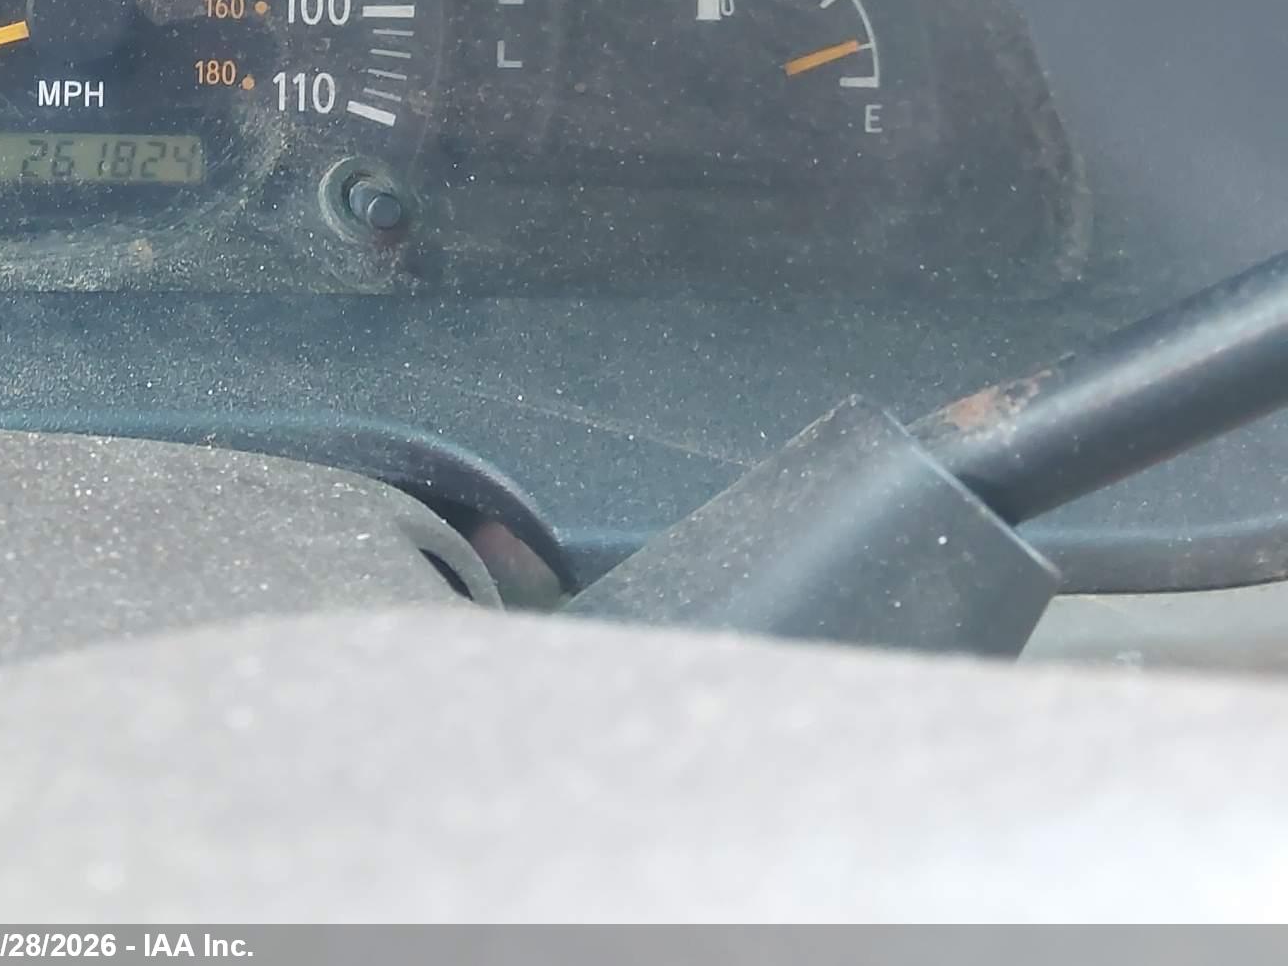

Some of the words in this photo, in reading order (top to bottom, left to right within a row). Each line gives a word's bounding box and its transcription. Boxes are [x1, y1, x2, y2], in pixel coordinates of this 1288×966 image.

[497, 41, 523, 69] L
[194, 60, 237, 86] 180
[38, 81, 104, 107] MPH
[271, 72, 336, 114] 110
[865, 105, 883, 133] E
[22, 138, 197, 178] 261824
